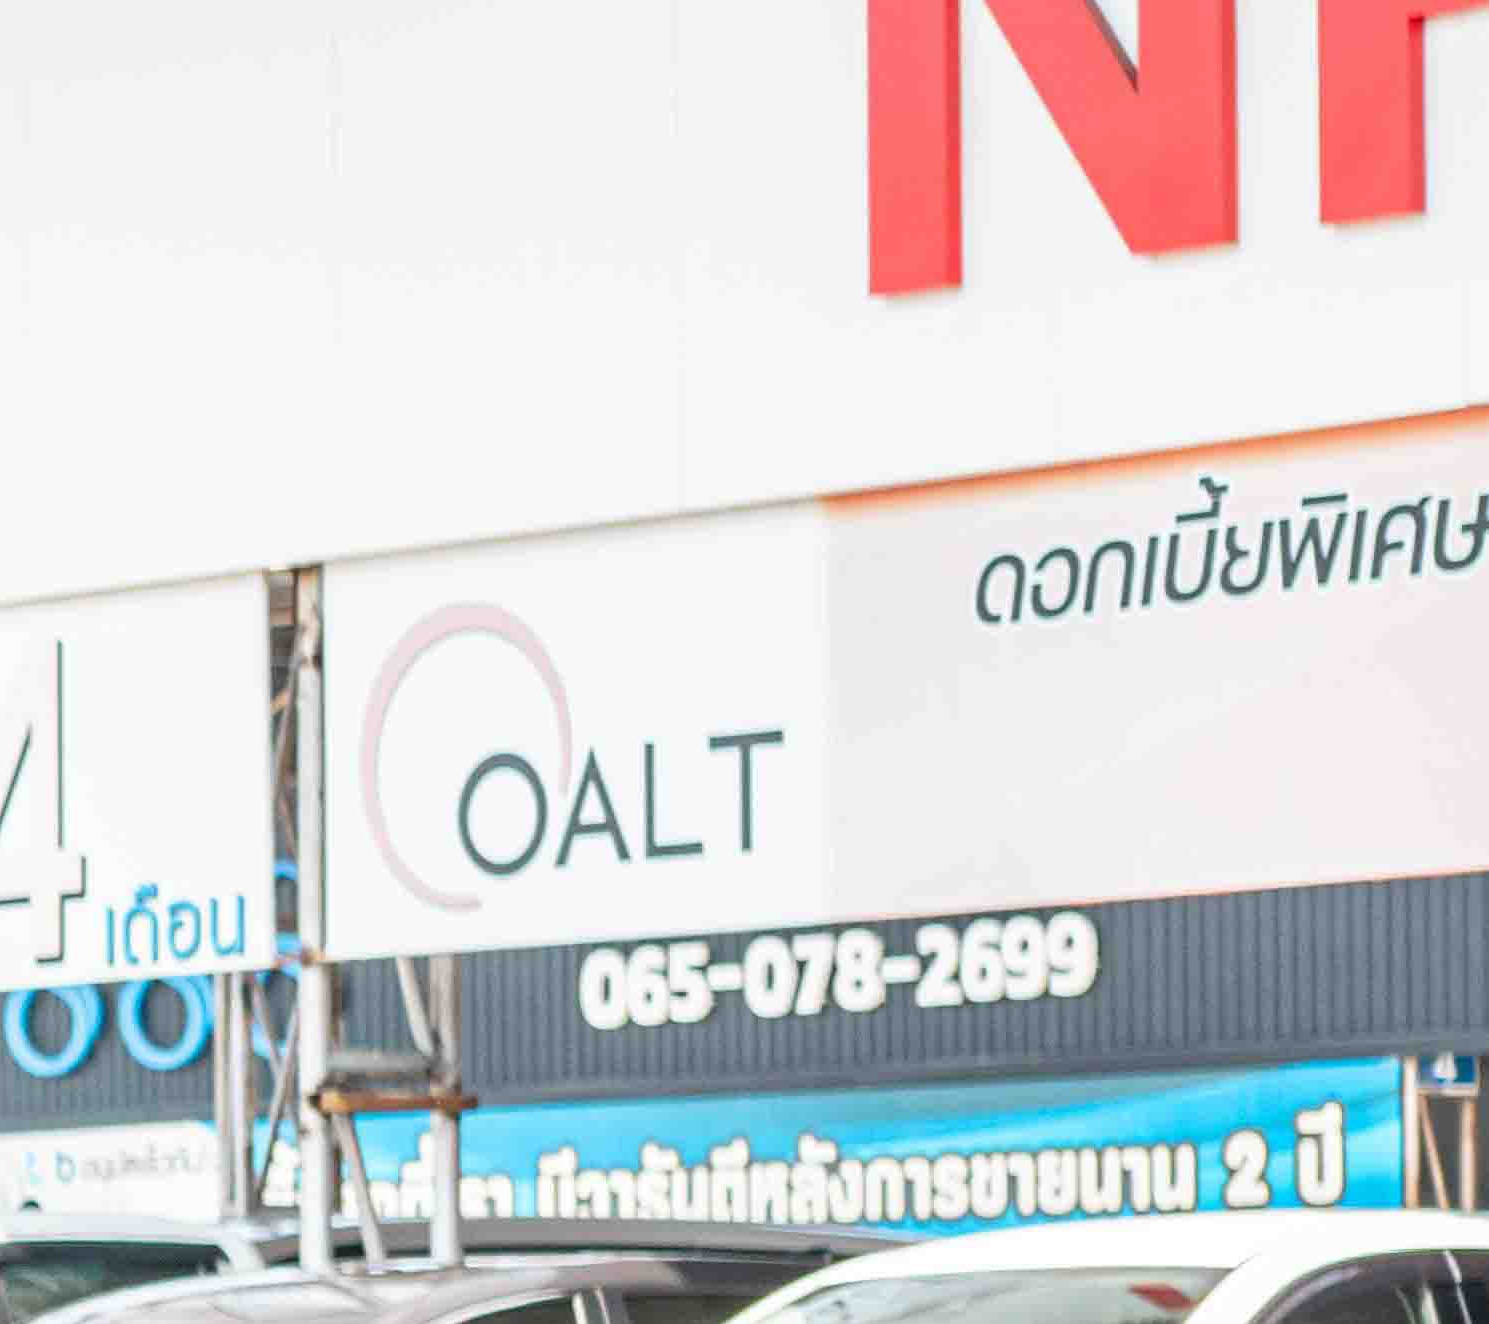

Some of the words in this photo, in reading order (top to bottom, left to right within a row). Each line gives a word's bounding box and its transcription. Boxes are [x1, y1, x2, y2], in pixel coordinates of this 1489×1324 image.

[104, 880, 250, 968] เดือน
[576, 911, 1101, 1031] 065-078-2699
[1222, 1128, 1271, 1210] 2
[1294, 1098, 1347, 1208] ปี
